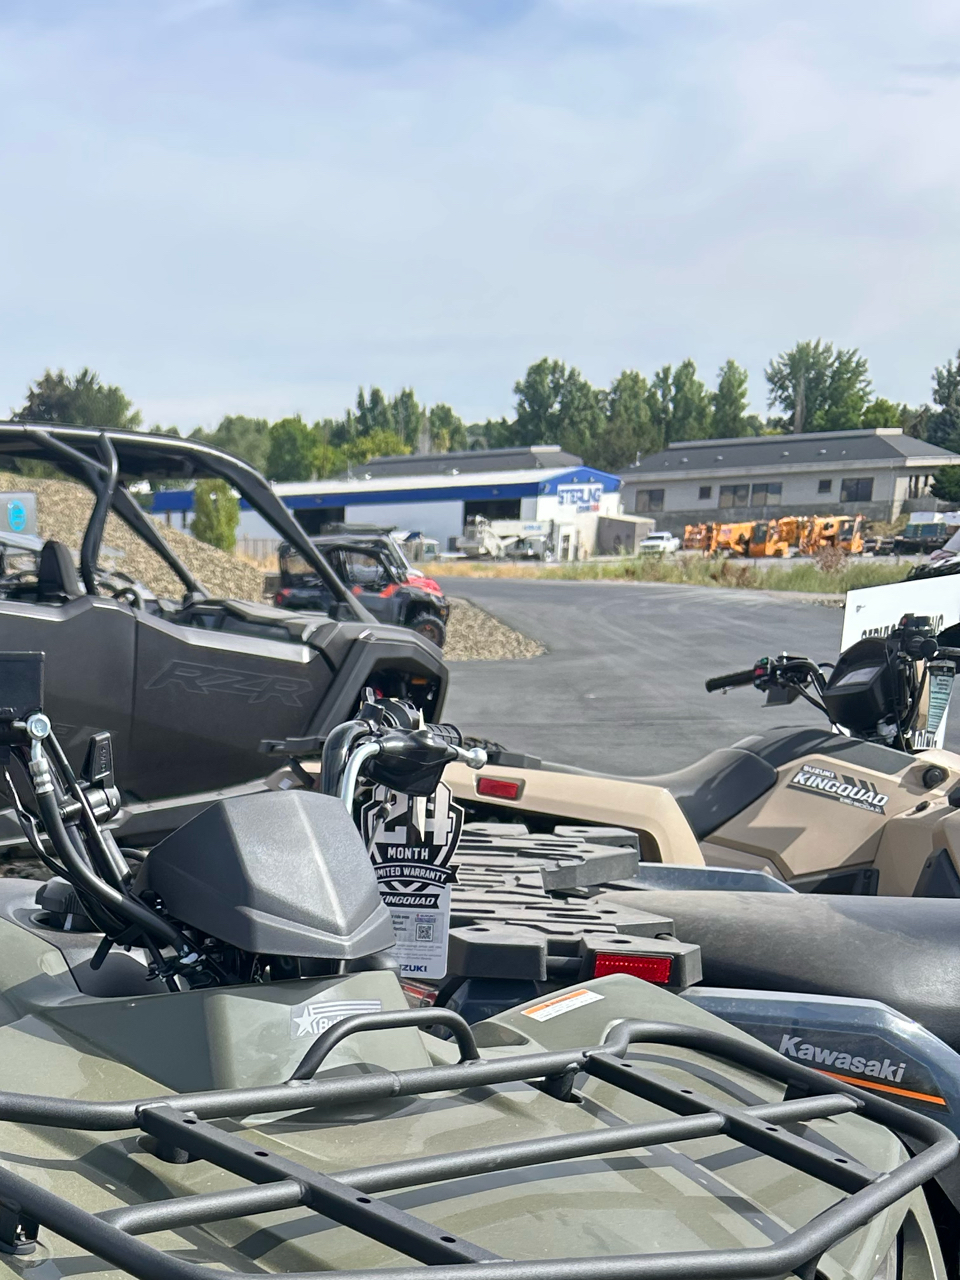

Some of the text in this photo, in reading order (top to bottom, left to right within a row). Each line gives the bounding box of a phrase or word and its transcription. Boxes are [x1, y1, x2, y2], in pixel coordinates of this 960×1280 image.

[144, 660, 315, 708] RZR
[803, 765, 835, 777] SUZUKI
[793, 772, 889, 806] KINGQUAD
[387, 847, 429, 860] MONTH
[376, 867, 447, 882] IMITED WARRANTY
[401, 964, 427, 972] ZUKI
[778, 1034, 906, 1082] Kawasaki
